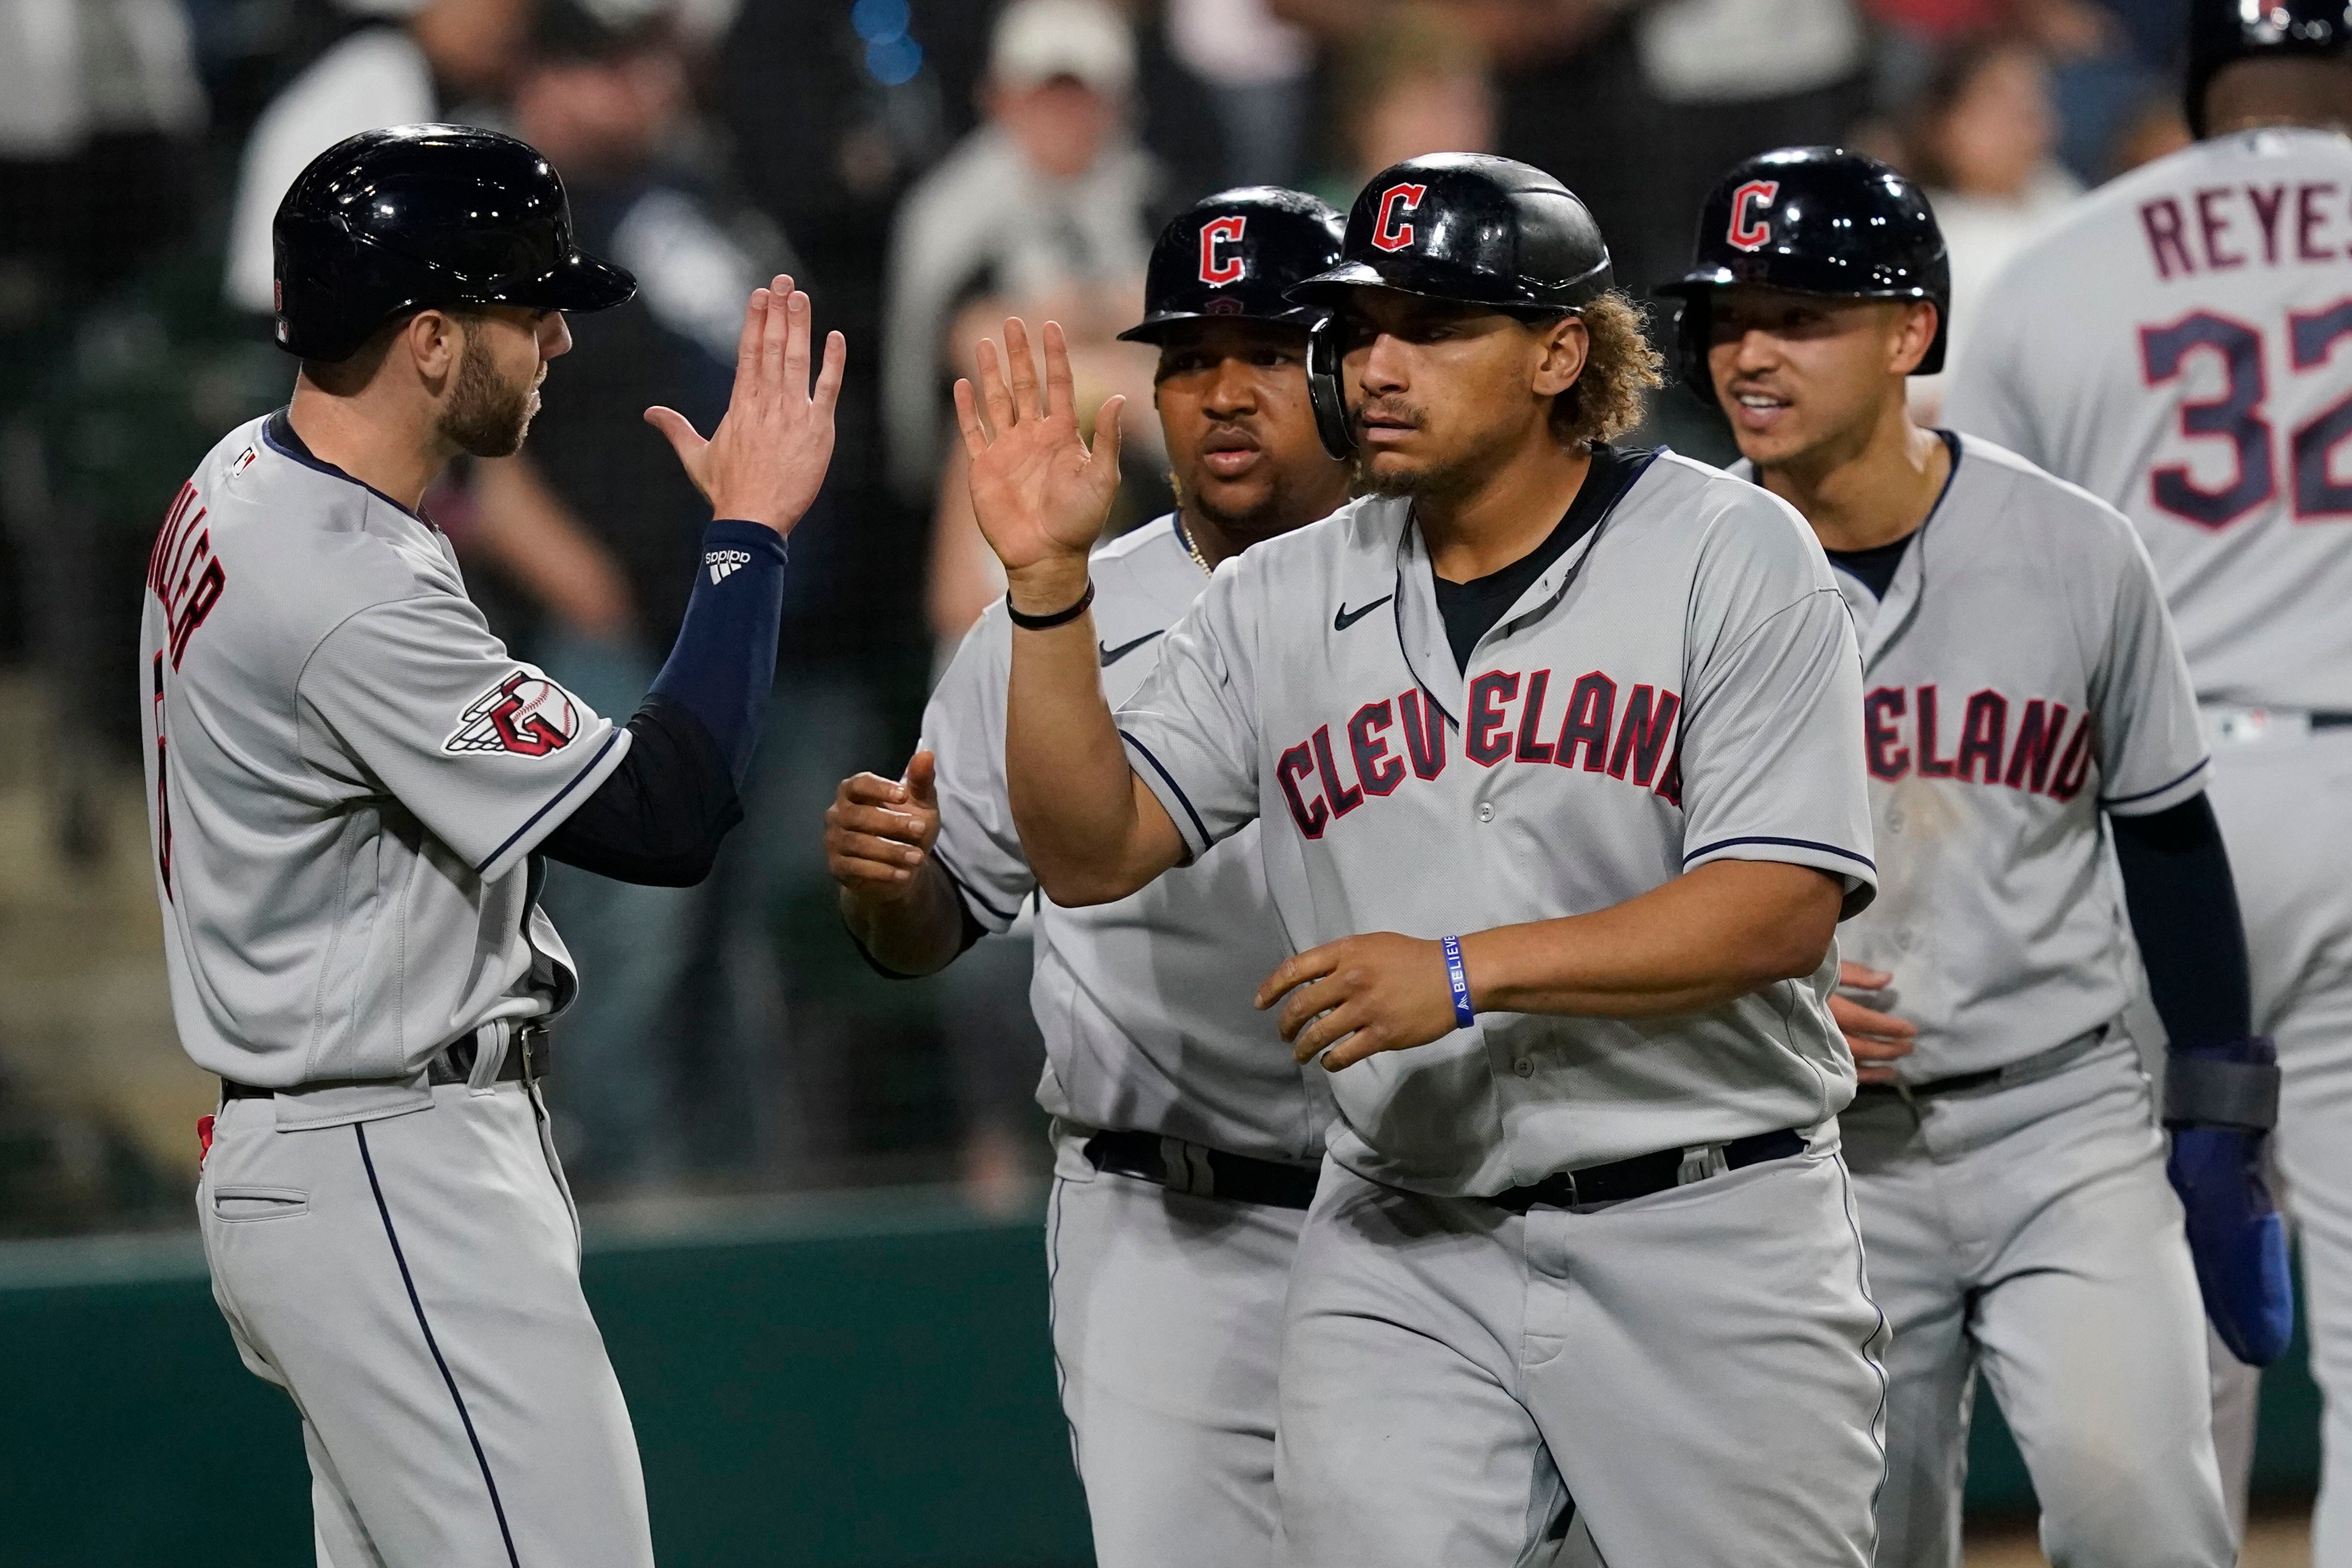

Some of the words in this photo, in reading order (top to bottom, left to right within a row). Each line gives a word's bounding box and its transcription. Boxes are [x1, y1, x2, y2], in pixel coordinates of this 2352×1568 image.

[1372, 182, 1427, 252] C
[1726, 179, 1780, 250] C
[2139, 182, 2352, 278] REYE
[1199, 216, 1247, 286] C
[148, 480, 226, 675] ILLER
[706, 550, 751, 564] adidas
[1277, 669, 1683, 840] CLEVELAN
[1444, 935, 1466, 993] BELIEVE
